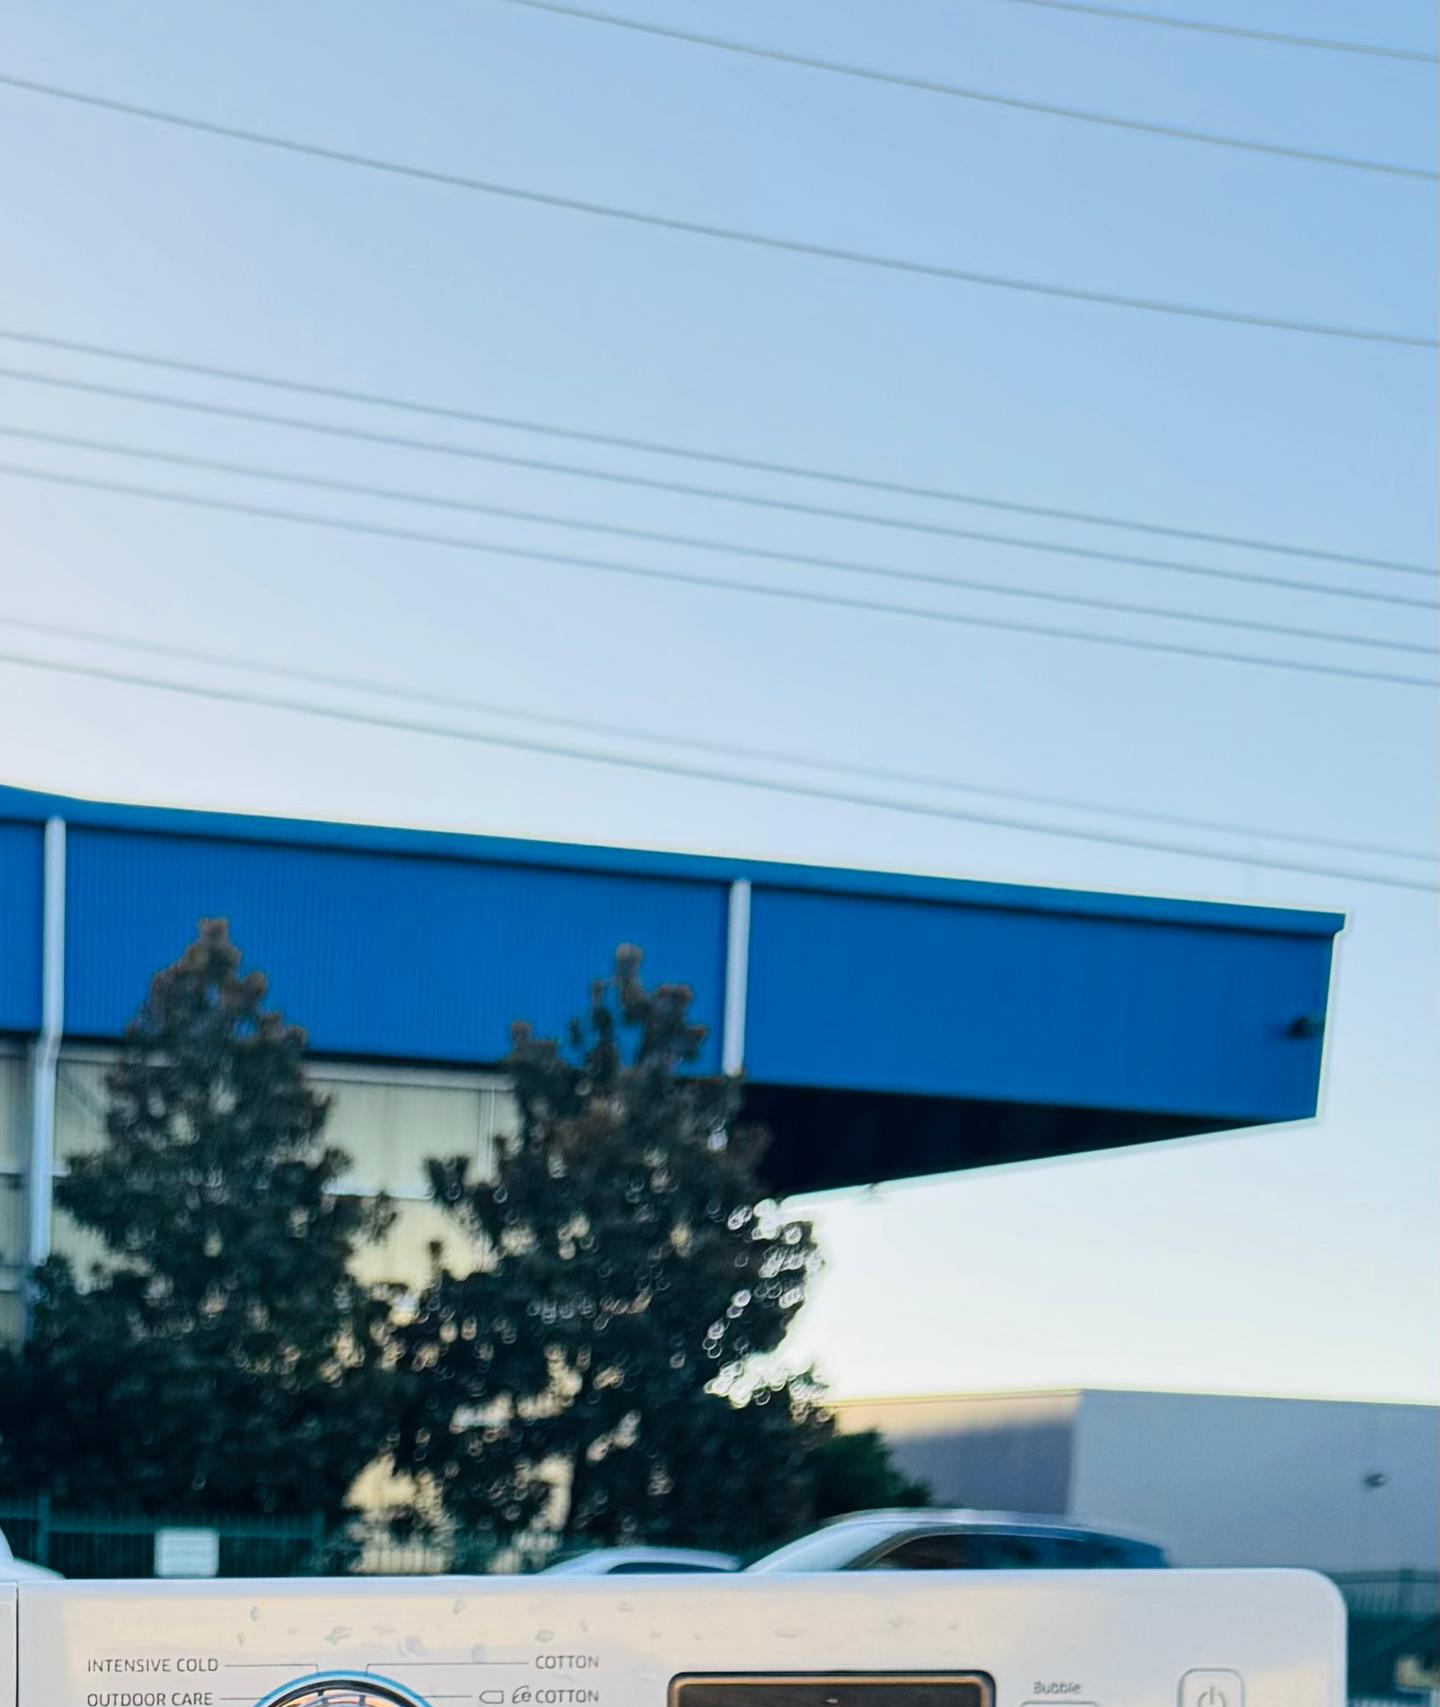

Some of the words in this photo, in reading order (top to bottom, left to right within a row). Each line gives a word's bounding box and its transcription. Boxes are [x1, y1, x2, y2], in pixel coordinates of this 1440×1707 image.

[87, 1658, 171, 1673] INTENSIVE
[176, 1658, 219, 1673] COLD
[535, 1655, 599, 1670] COTTON
[1033, 1680, 1082, 1695] Bubble
[87, 1692, 166, 1707] OUTDOOR
[171, 1692, 213, 1707] CARE
[535, 1689, 599, 1704] COTTON
